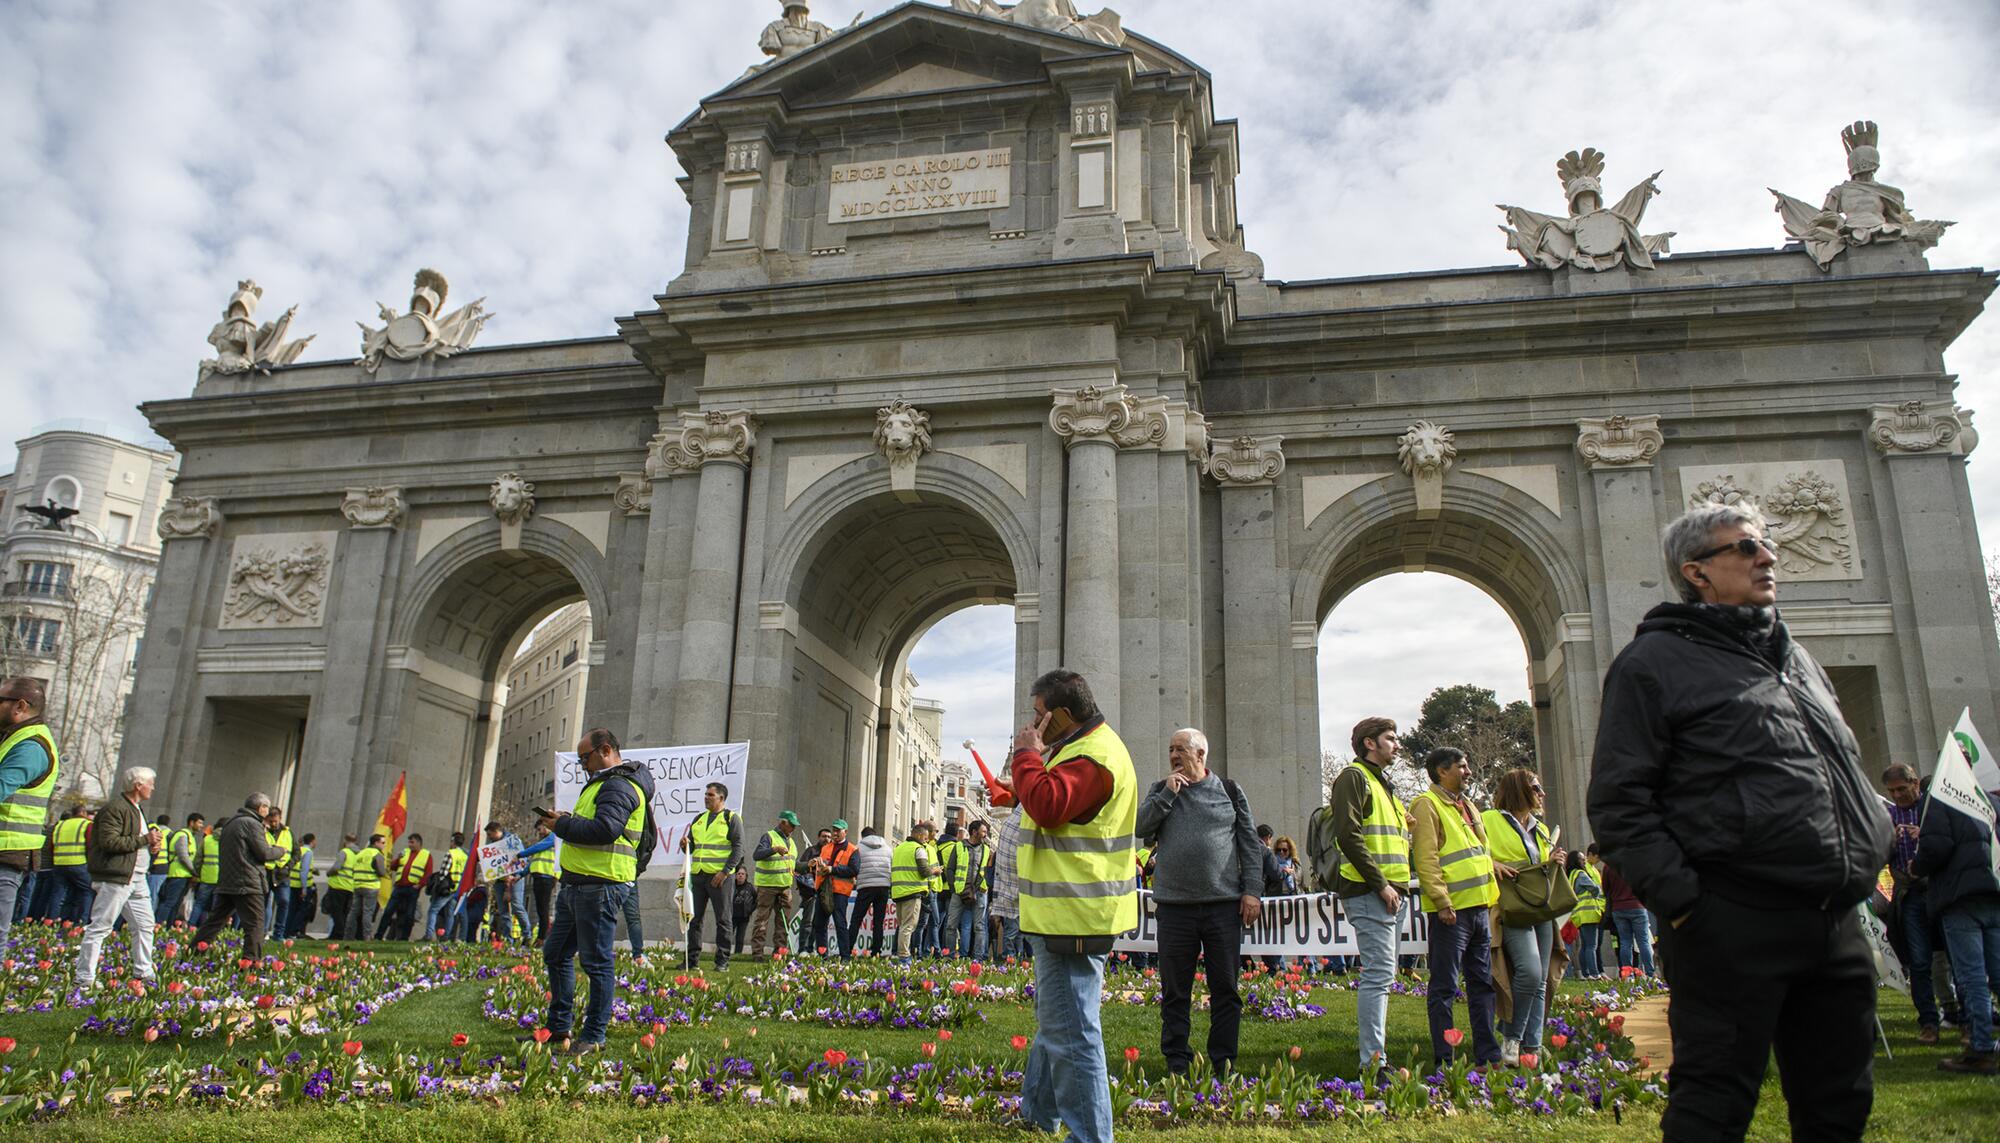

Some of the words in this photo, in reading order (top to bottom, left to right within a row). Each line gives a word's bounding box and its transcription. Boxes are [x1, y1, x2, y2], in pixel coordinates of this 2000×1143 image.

[831, 167, 887, 184] REGE
[893, 156, 981, 178] CAROLO
[886, 177, 952, 196] ANNO
[840, 189, 998, 218] MDCCLXXVIII
[653, 787, 701, 816] ASE
[1240, 896, 1310, 945] AMPO
